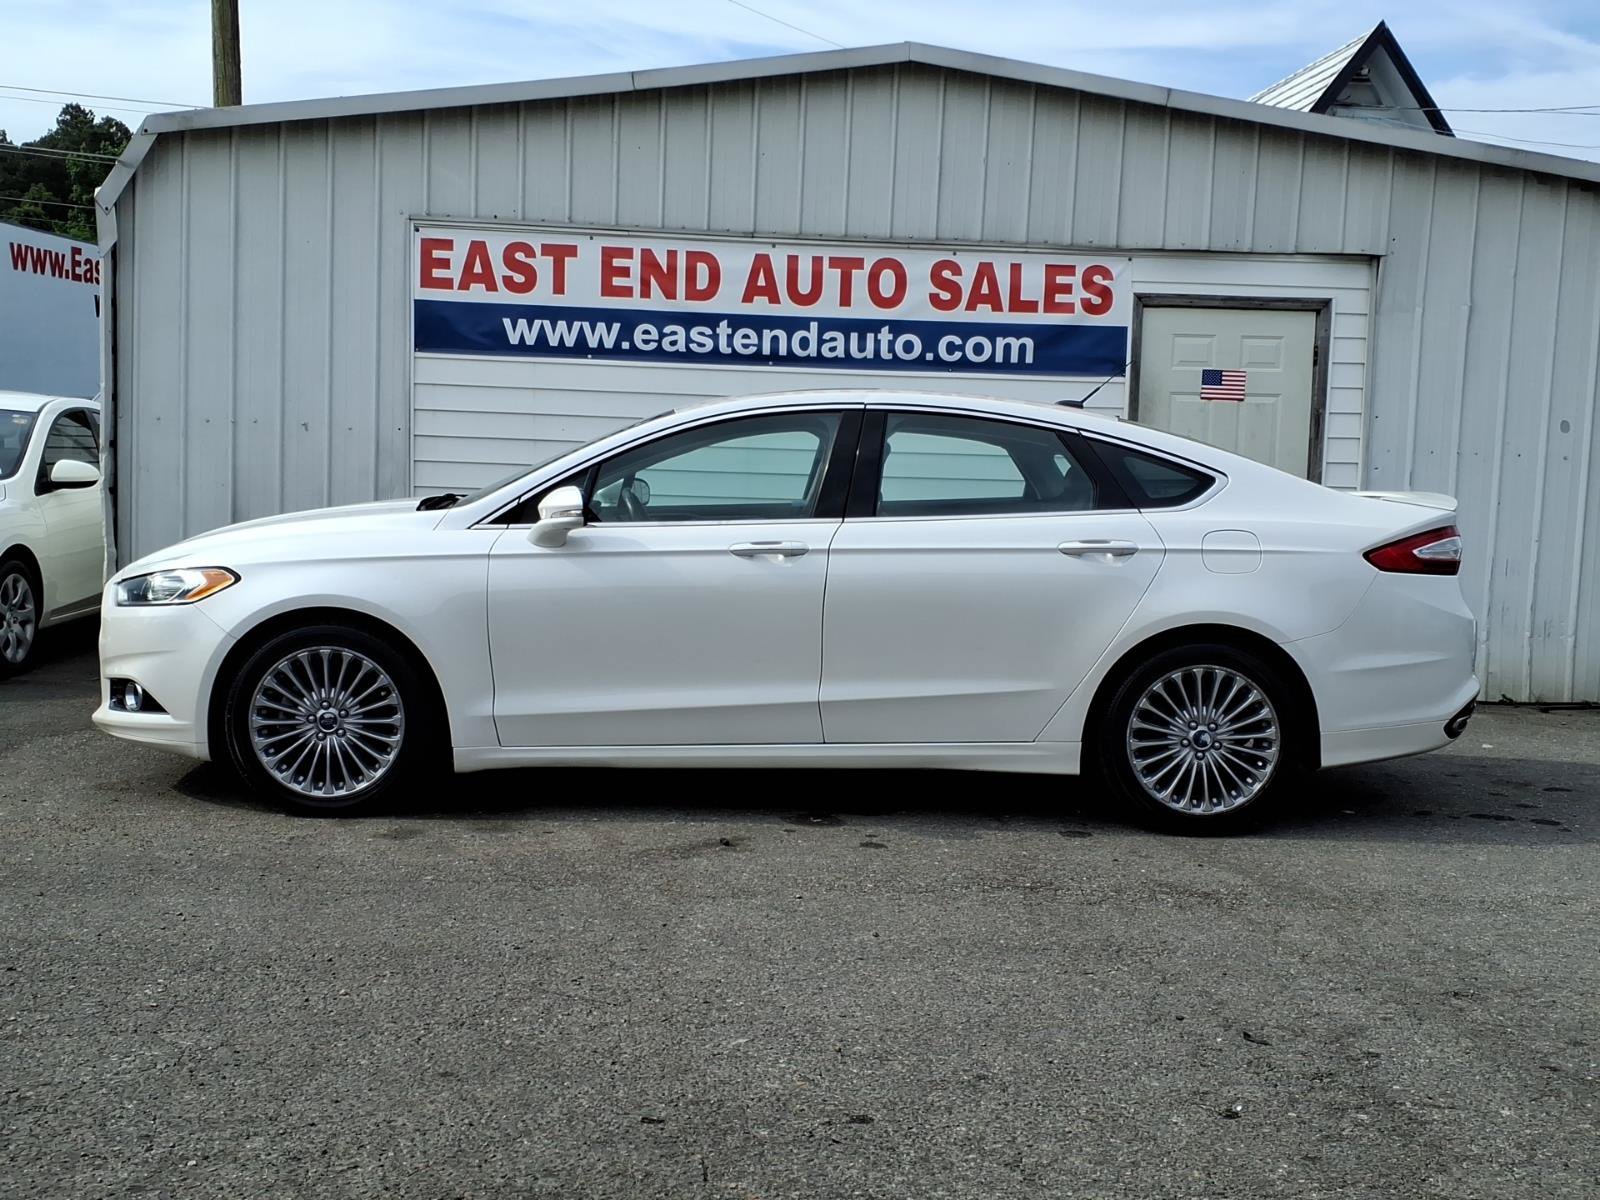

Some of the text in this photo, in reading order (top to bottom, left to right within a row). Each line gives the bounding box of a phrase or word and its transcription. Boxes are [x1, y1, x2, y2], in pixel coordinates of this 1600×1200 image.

[419, 237, 1115, 317] EAST END AUTO SALES
[502, 316, 1035, 365] www.eastendauto.com
